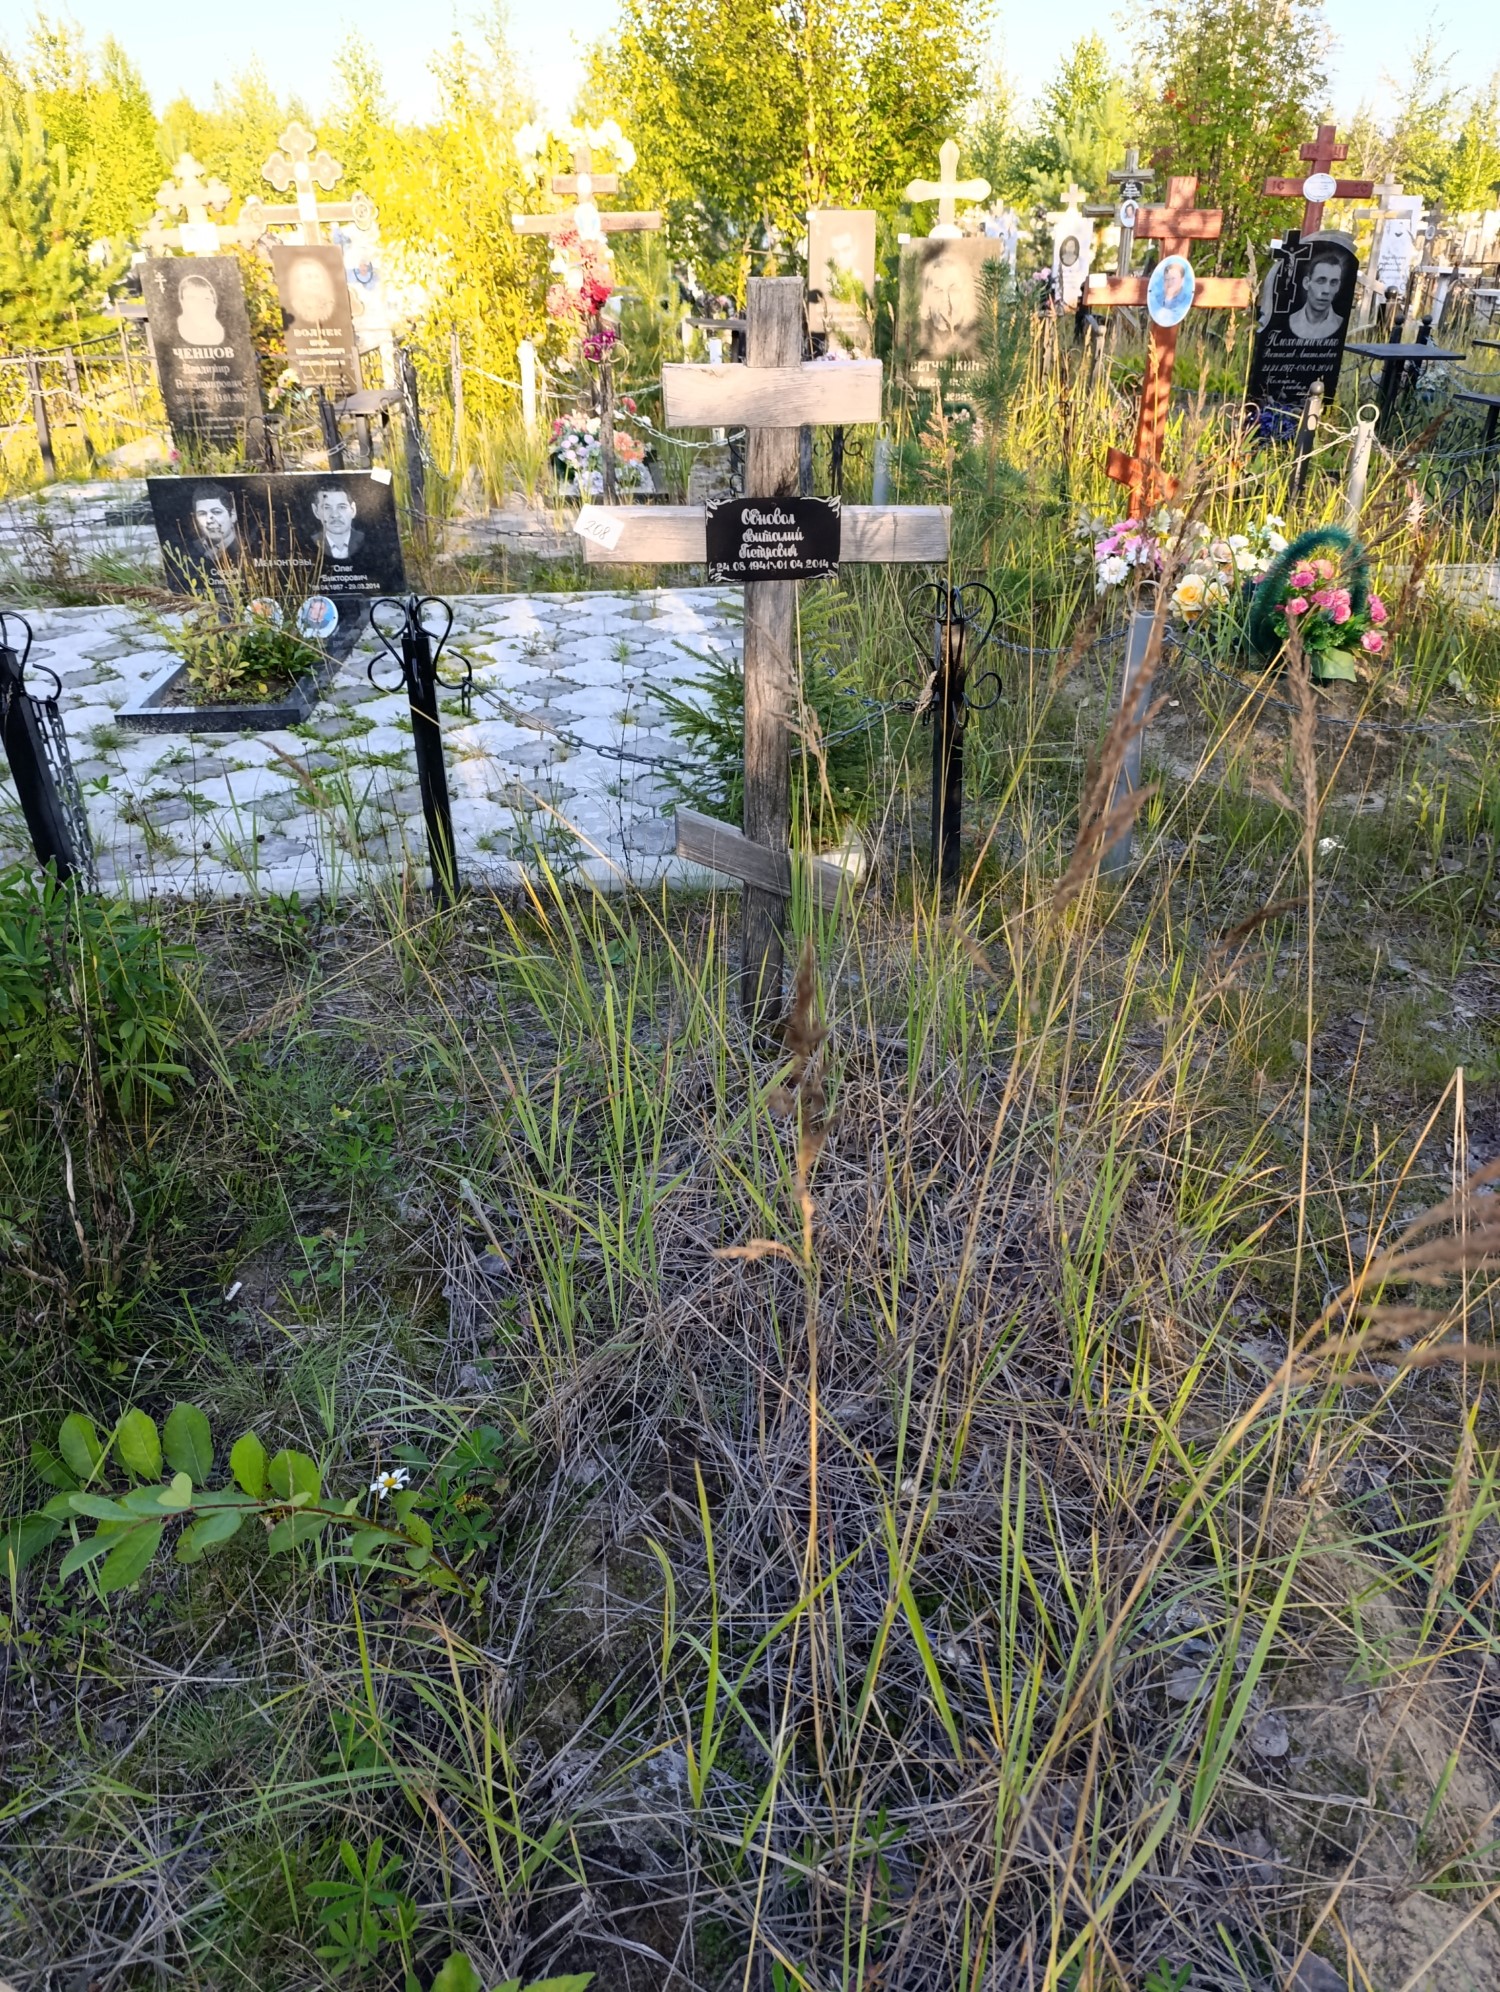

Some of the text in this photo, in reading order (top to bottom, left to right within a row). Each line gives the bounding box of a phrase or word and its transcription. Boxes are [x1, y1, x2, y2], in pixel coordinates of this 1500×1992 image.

[172, 347, 235, 360] ЧЕНЦОВ
[182, 363, 231, 376] Владимир
[910, 360, 980, 372] ВЕТЧИКИН
[583, 520, 611, 541] 208
[742, 527, 805, 544] Виталий
[738, 543, 799, 561] Петрович
[333, 565, 353, 573] Олег
